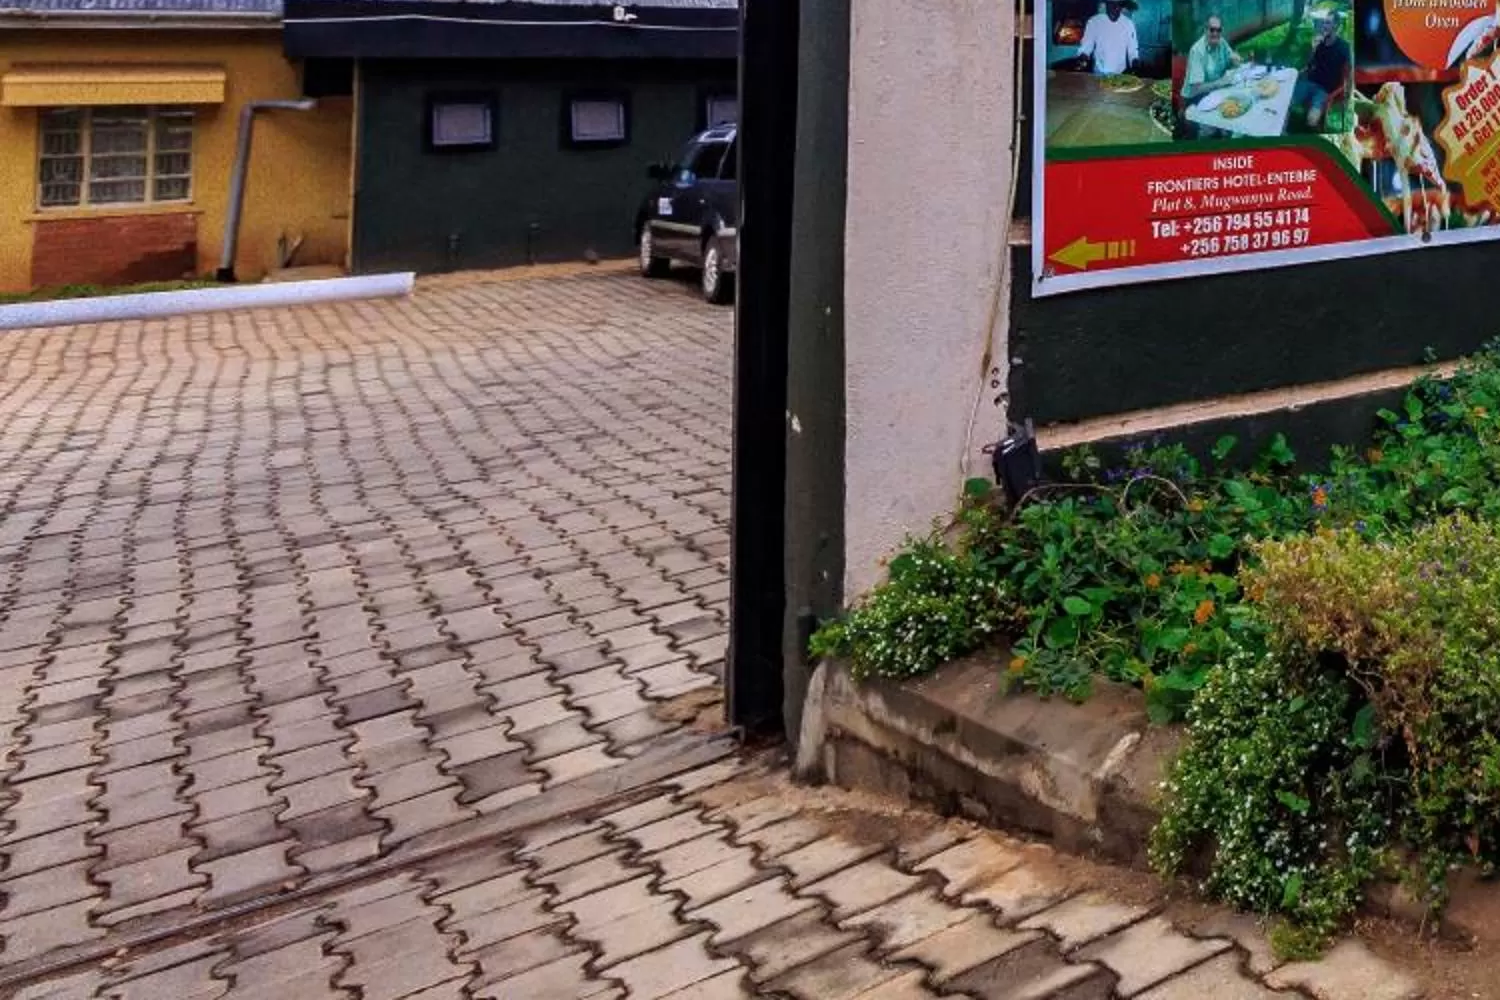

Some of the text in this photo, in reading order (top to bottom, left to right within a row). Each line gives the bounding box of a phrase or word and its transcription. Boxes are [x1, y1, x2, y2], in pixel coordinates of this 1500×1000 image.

[1425, 11, 1459, 29] Oven
[1456, 75, 1489, 111] Order
[1452, 121, 1469, 142] At
[1472, 121, 1495, 145] Get
[1213, 155, 1254, 170] INSIDE
[1147, 176, 1219, 195] FRONTIERS
[1152, 197, 1181, 213] Plot
[1200, 193, 1273, 210] Mugwanya
[1152, 221, 1180, 238] Tel:
[1183, 215, 1222, 235] +256
[1225, 213, 1251, 231] 794
[1253, 211, 1273, 228] 55
[1275, 209, 1291, 224] 41
[1180, 237, 1220, 256] +256
[1252, 231, 1269, 248] 37
[1293, 227, 1310, 245] 97
